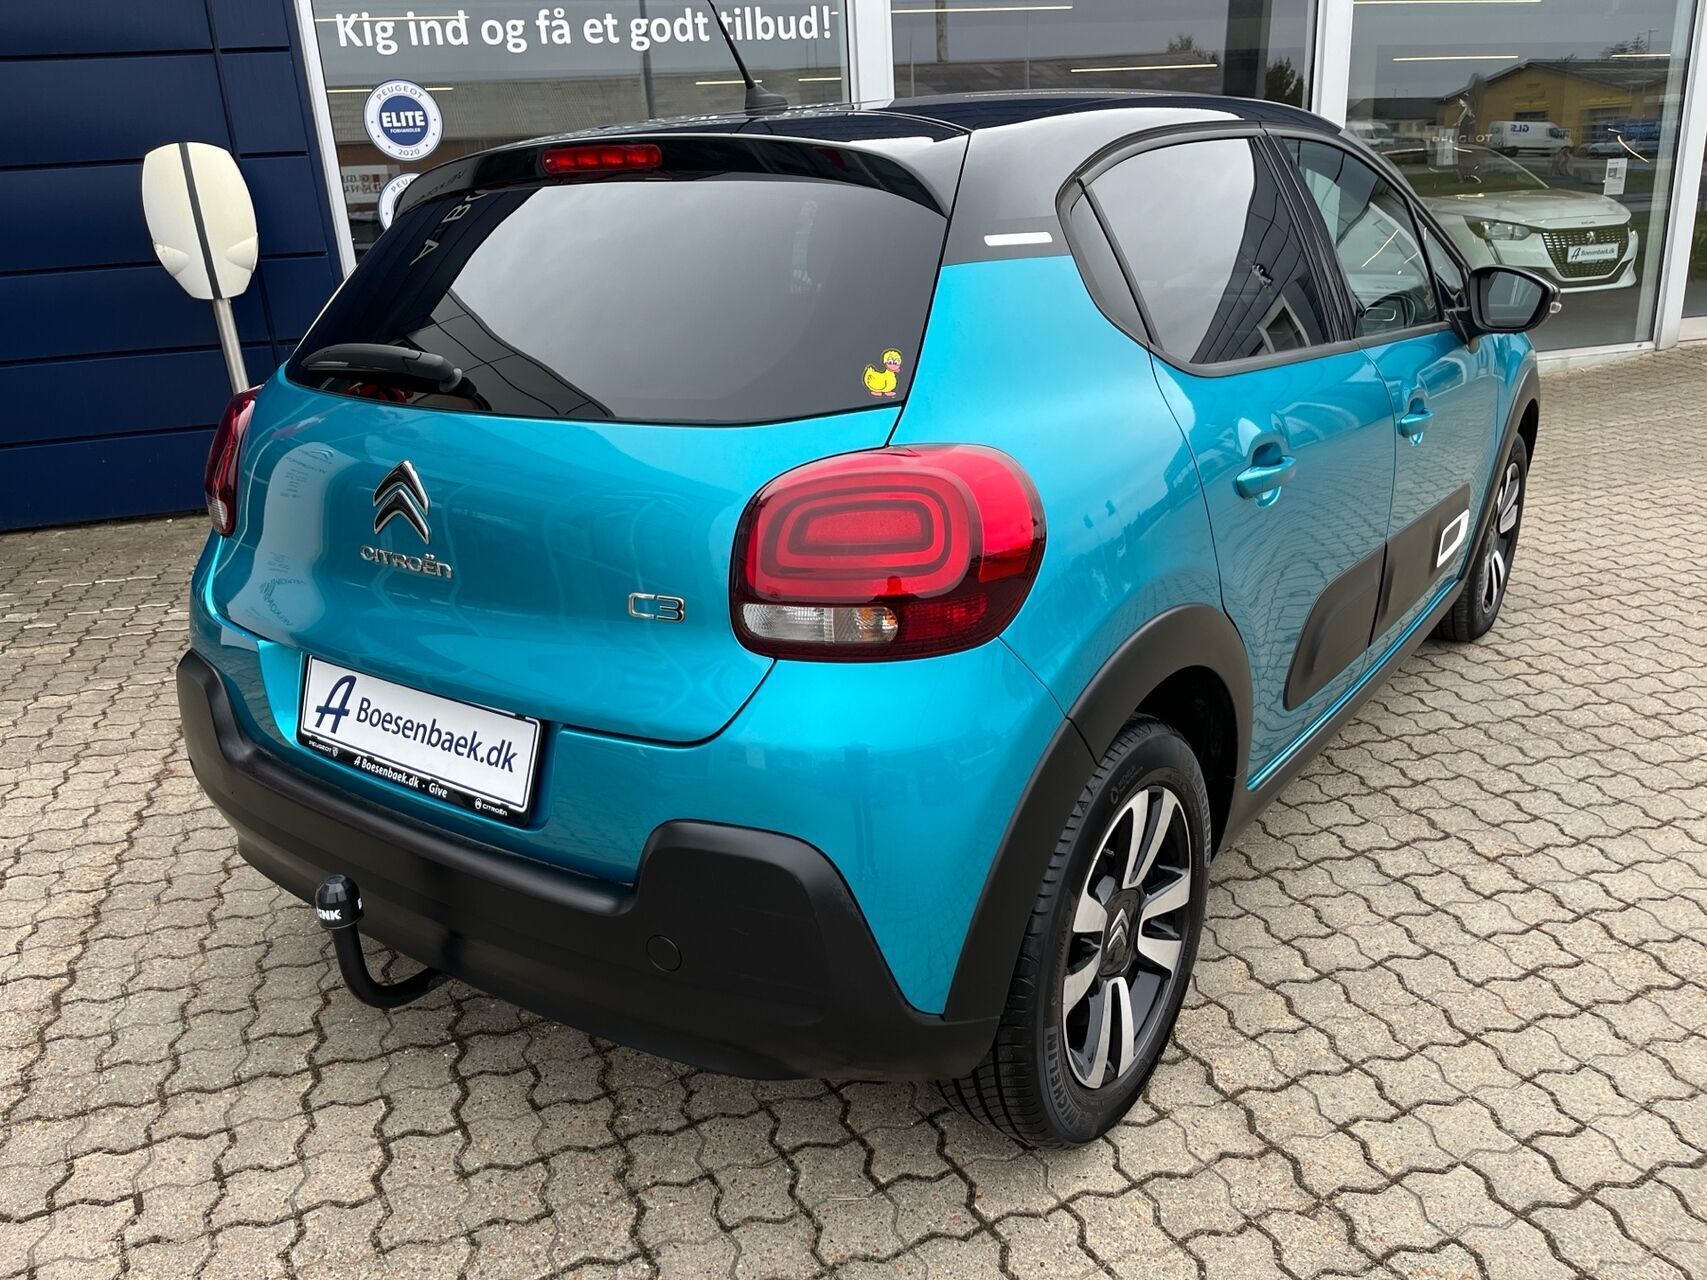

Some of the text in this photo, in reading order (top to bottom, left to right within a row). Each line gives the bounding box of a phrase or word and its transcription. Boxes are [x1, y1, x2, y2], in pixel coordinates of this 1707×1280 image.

[336, 5, 832, 56] Kig ind og få et godt tilbud!
[376, 84, 425, 101] PEUGEOT
[381, 110, 426, 128] ELITE
[398, 148, 421, 157] 2020
[360, 545, 453, 579] CITROËN
[628, 592, 685, 622] C3
[315, 674, 518, 773] A Boesenbaek.dk
[308, 740, 332, 753] PEUGEOT
[361, 758, 420, 788] Boesenbaek.dk
[428, 782, 448, 798] Give
[1046, 1031, 1080, 1128] MICHELIN
